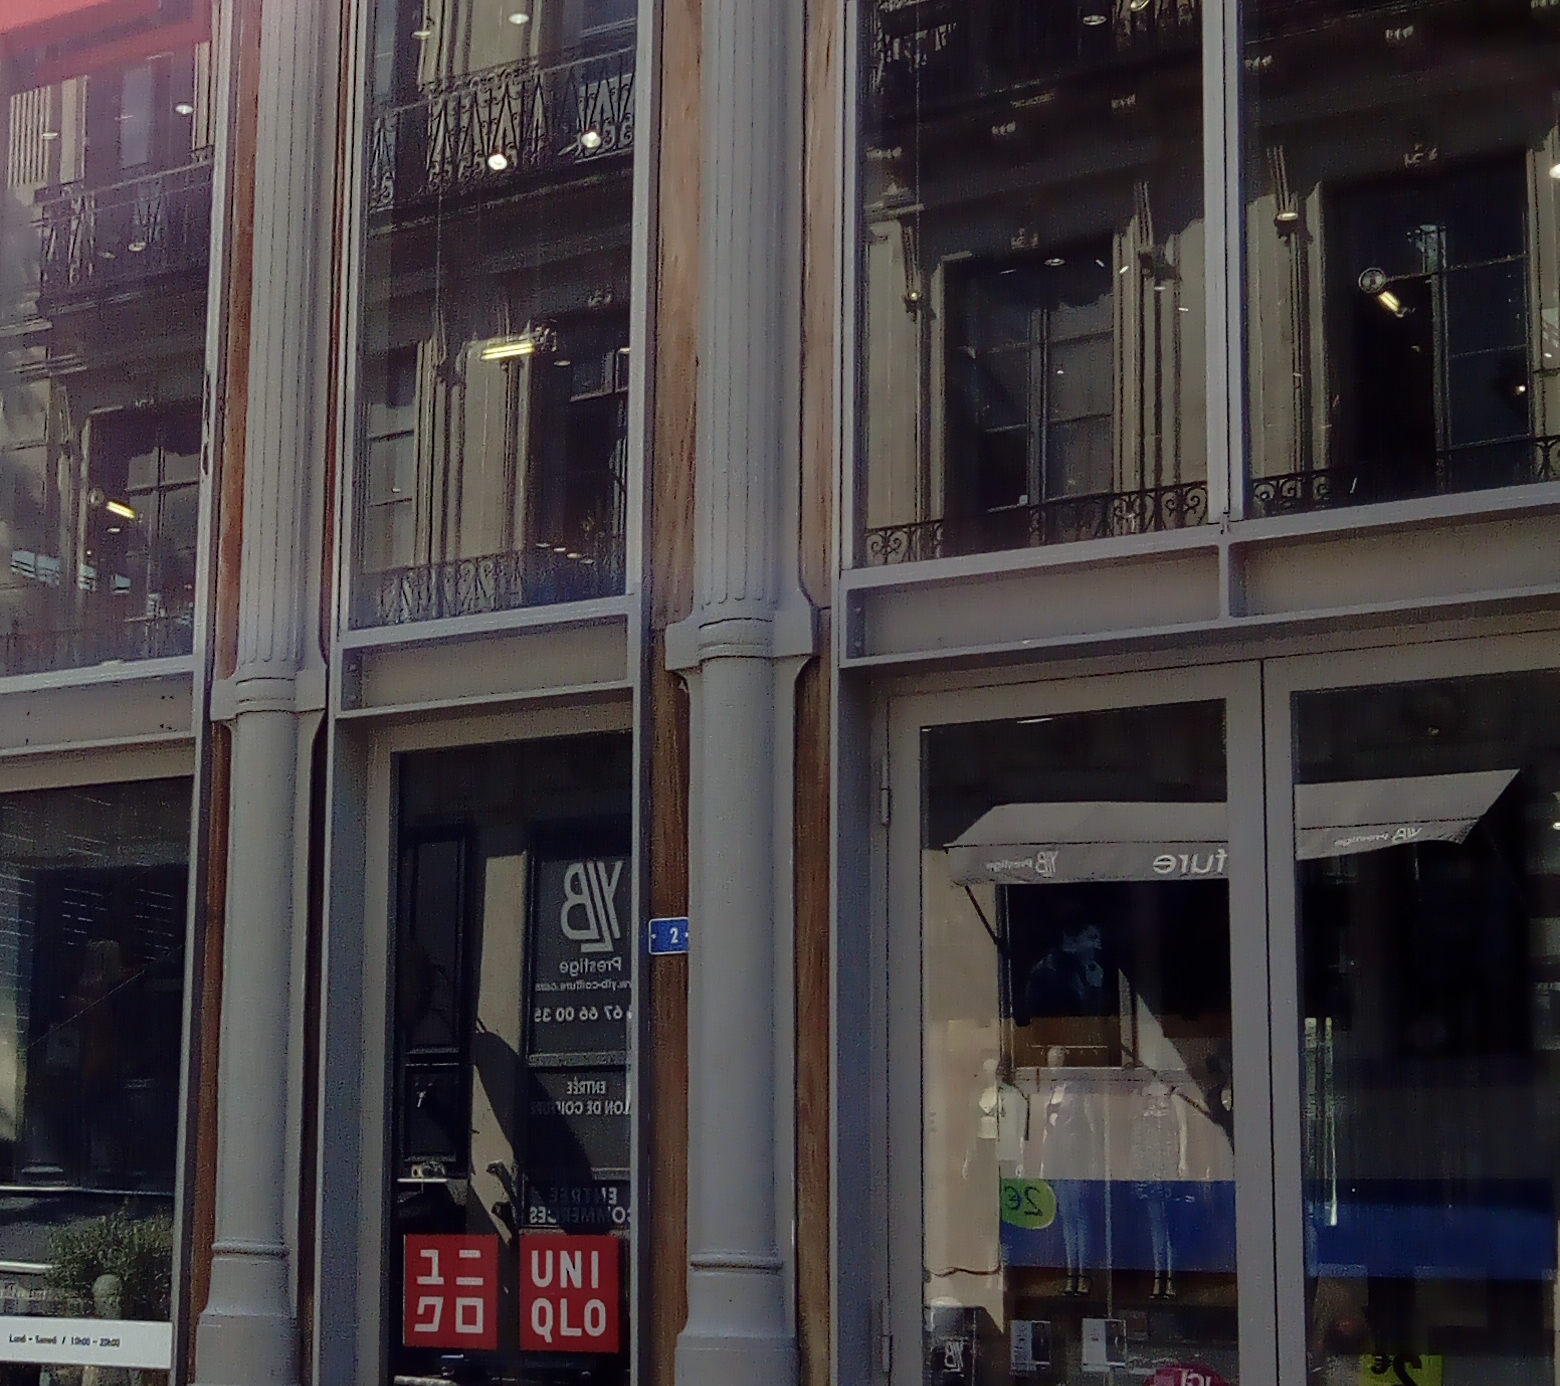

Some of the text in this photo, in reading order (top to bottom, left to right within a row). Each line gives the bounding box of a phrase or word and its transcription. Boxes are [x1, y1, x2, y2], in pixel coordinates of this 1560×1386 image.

[669, 926, 679, 944] 2
[416, 1248, 484, 1286] ユニ
[531, 1249, 599, 1289] UNI
[413, 1296, 484, 1334] クロ
[531, 1297, 606, 1343] QLO
